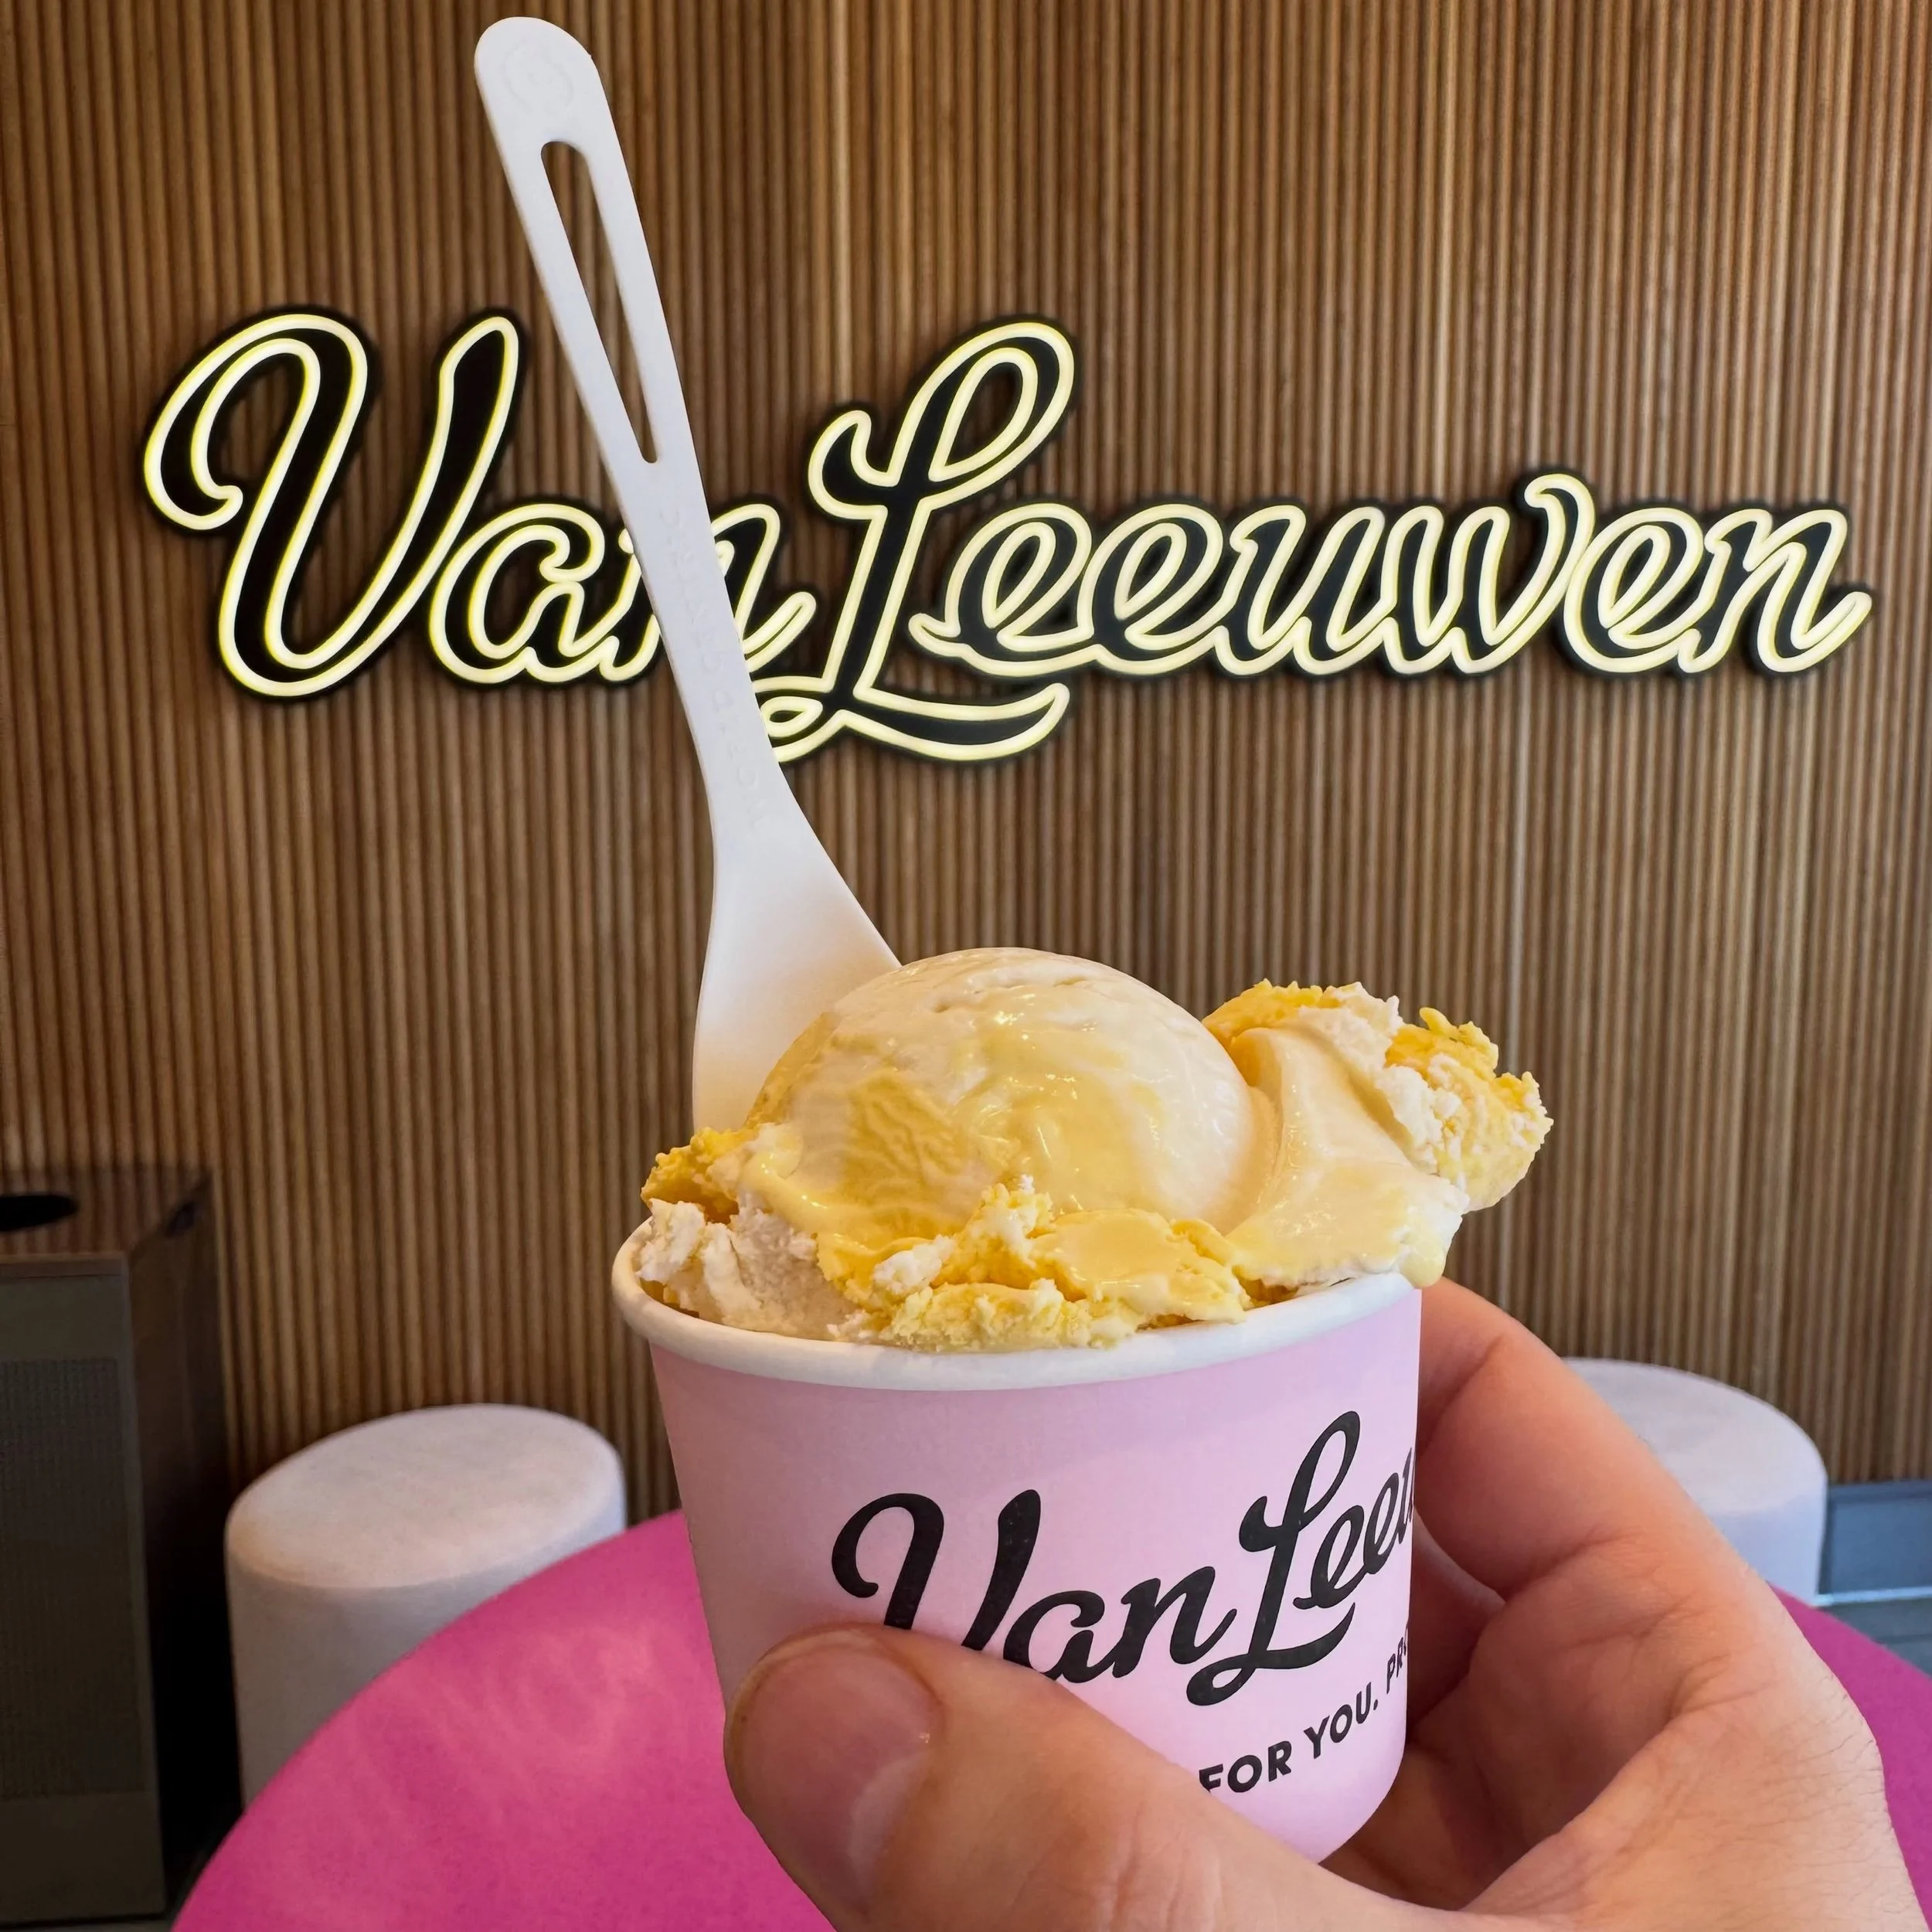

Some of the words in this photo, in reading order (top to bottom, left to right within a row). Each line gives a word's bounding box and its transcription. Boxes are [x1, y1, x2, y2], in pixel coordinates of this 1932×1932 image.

[753, 321, 1872, 761] Leeuwen
[832, 1489, 1236, 1684] Van
[1199, 1740, 1292, 1793] FOR
[1303, 1682, 1379, 1760] YOU.
